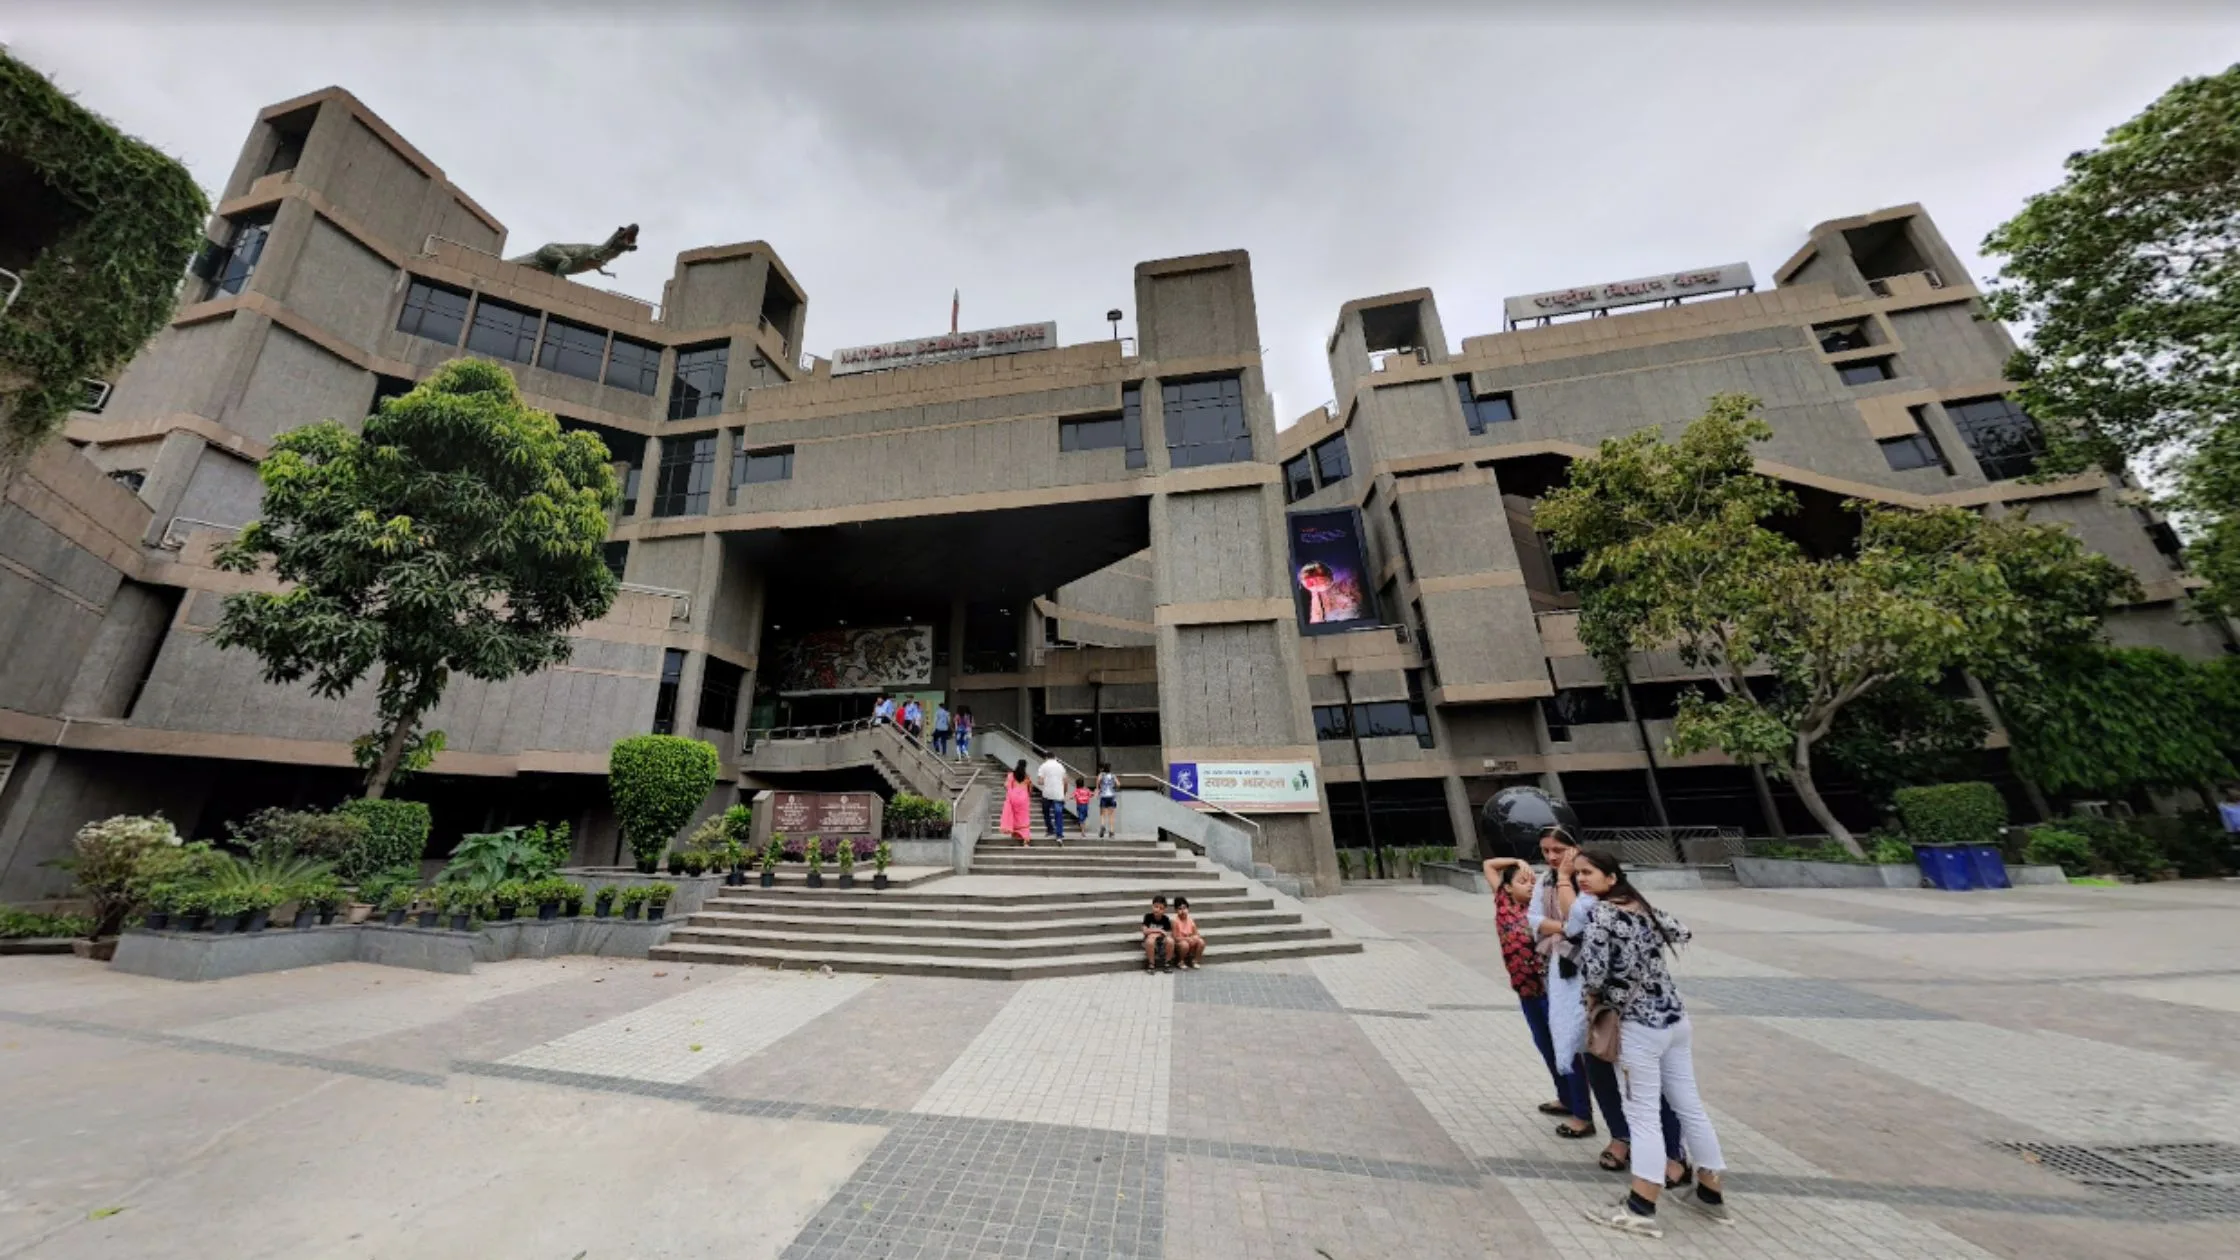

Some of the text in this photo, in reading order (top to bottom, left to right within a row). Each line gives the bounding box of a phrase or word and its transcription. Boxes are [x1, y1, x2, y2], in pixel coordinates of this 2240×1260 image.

[841, 325, 1046, 365] NATIONAL SCIENCE CENTRE
